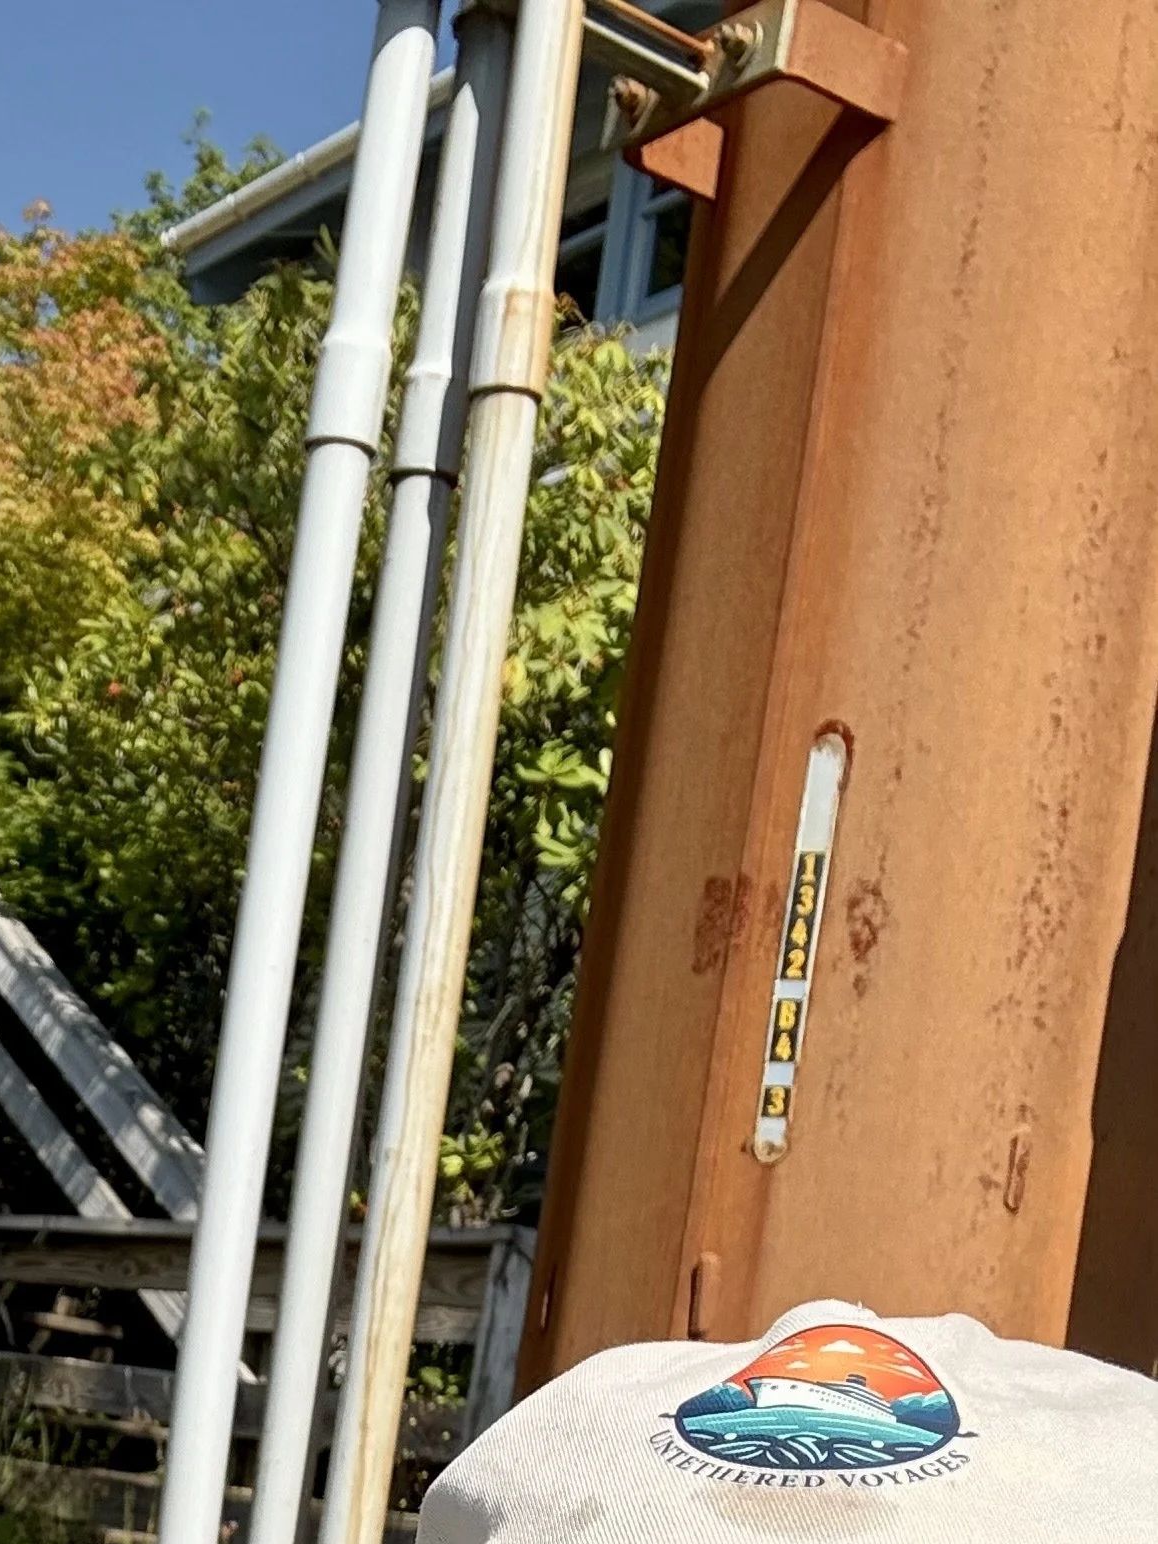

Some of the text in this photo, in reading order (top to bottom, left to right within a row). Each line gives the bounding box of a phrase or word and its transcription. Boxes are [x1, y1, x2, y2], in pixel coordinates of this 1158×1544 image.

[786, 854, 816, 978] 1342
[767, 1087, 786, 1116] 3
[649, 1429, 971, 1488] UNTETHERED VOYAGES
